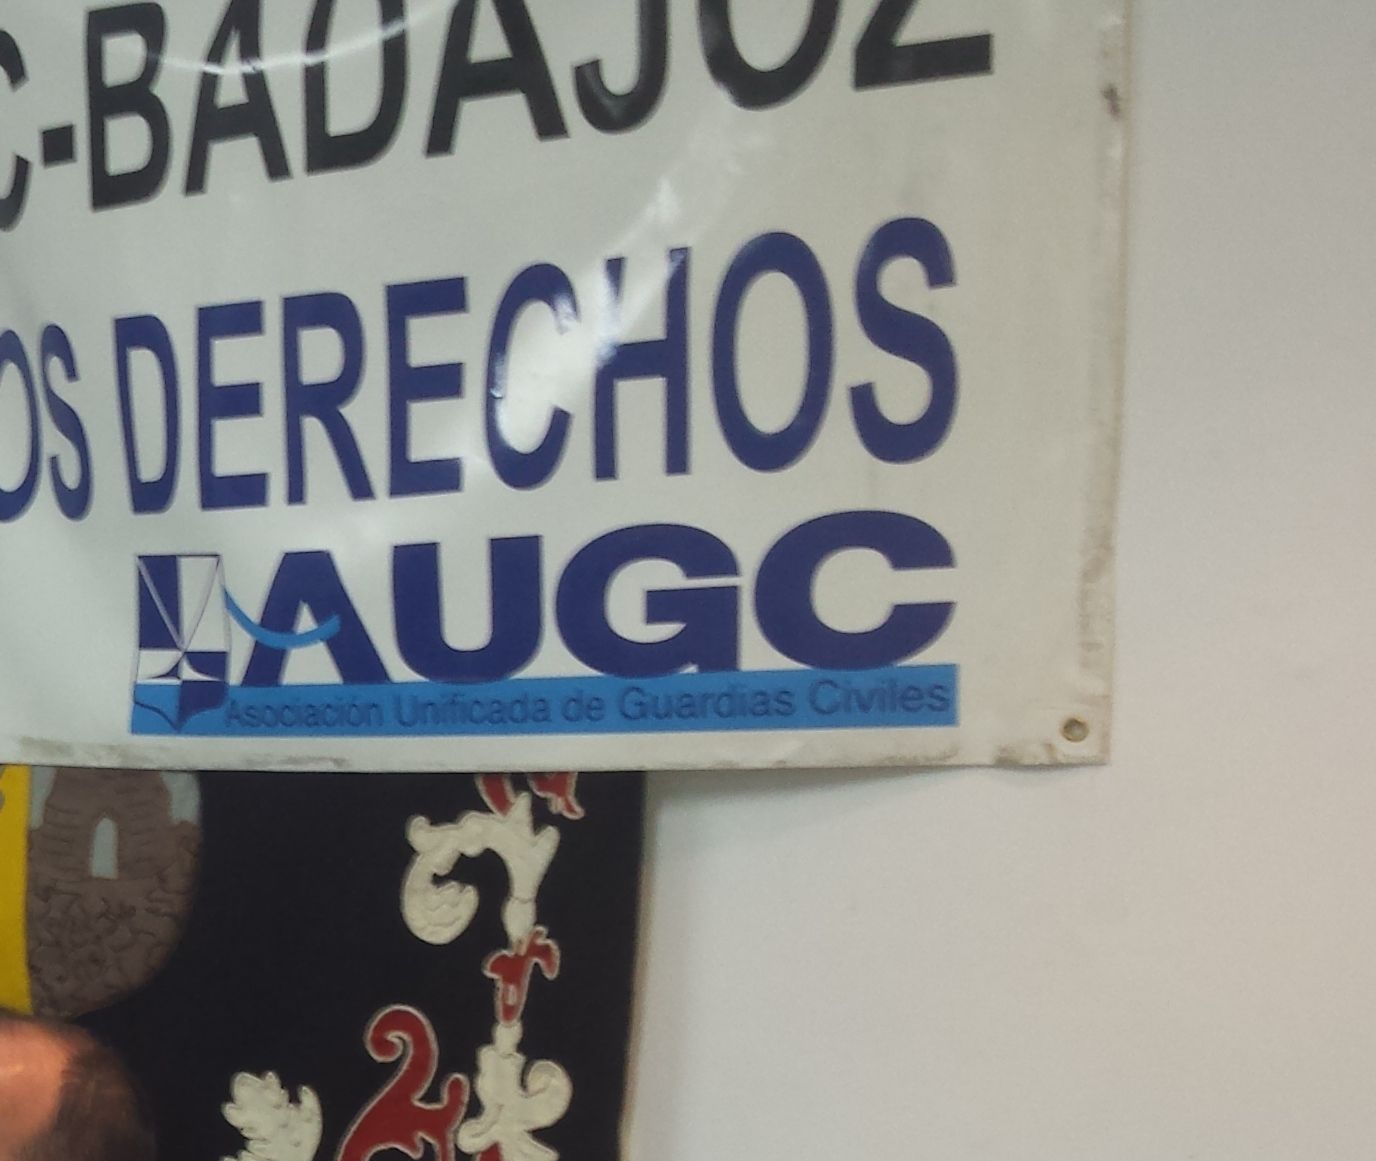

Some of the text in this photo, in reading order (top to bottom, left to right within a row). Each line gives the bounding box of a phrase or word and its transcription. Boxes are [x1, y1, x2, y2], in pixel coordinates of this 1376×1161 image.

[113, 217, 959, 515] DERECHOS
[396, 690, 548, 727] Unificada
[560, 690, 606, 723] de
[617, 682, 797, 722] Guardias
[808, 677, 951, 717] Civiles
